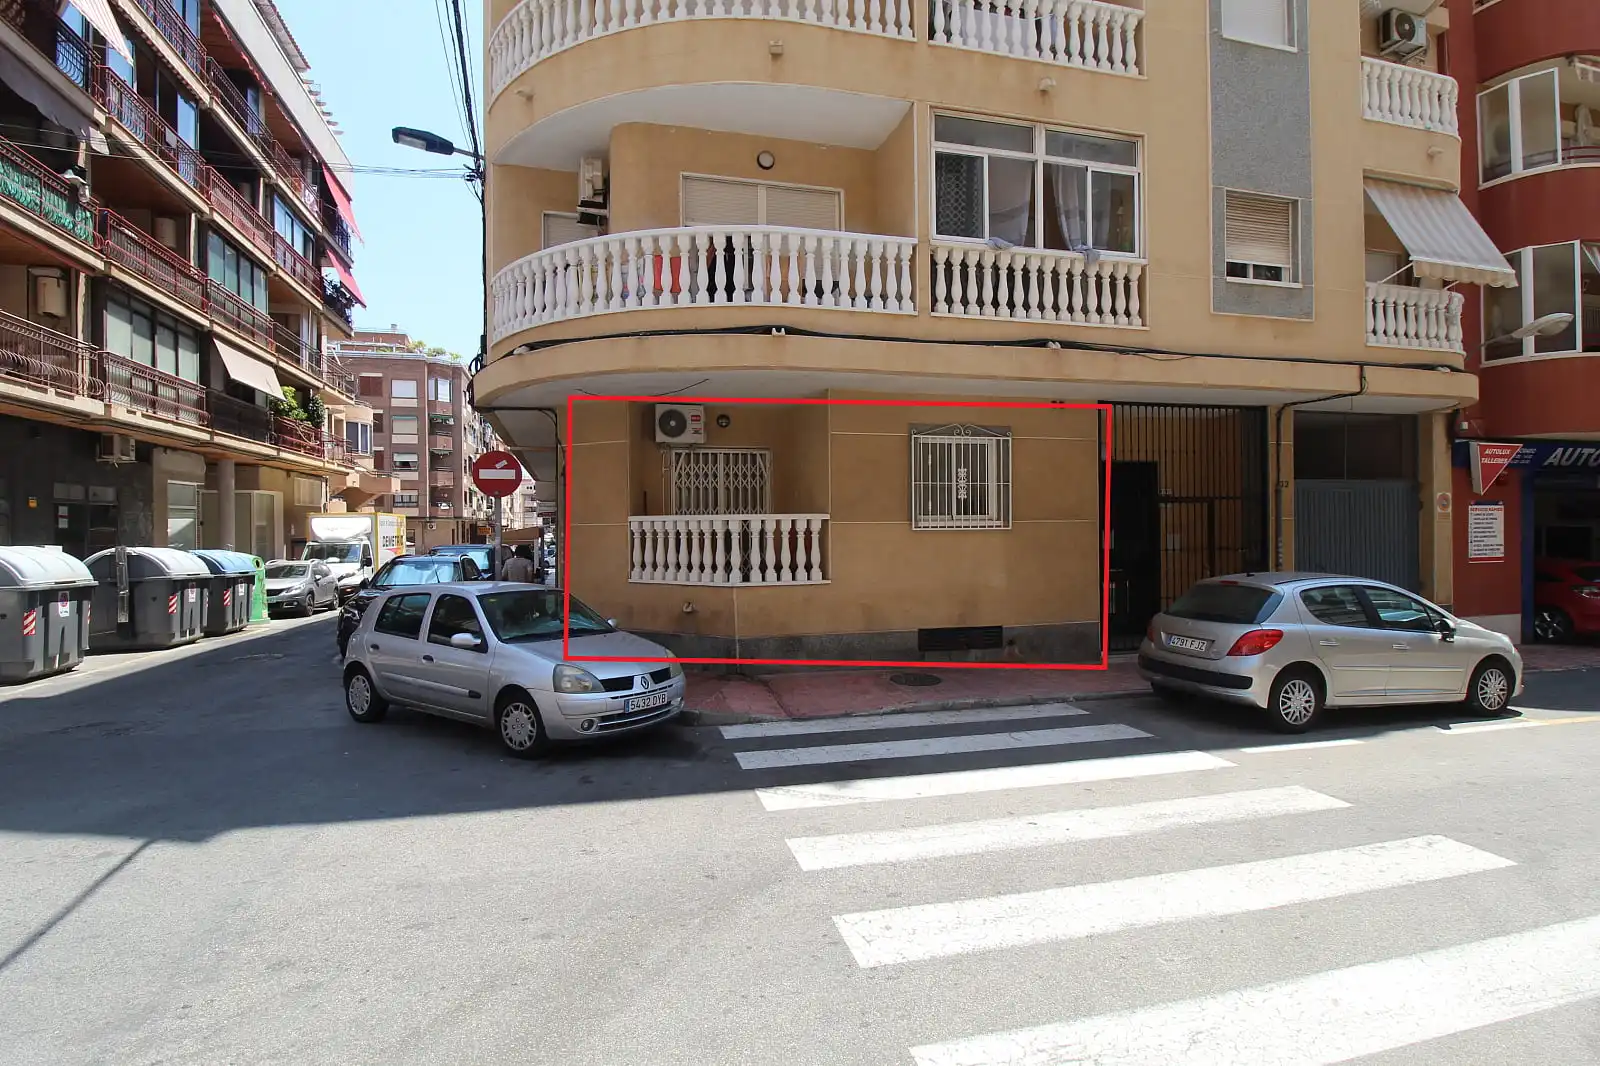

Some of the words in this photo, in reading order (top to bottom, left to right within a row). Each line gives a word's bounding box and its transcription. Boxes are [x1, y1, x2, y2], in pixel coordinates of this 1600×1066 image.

[1171, 637, 1188, 647] 4791
[1190, 640, 1206, 651] FJZ
[630, 697, 650, 710] 5432
[652, 693, 666, 706] DYB
